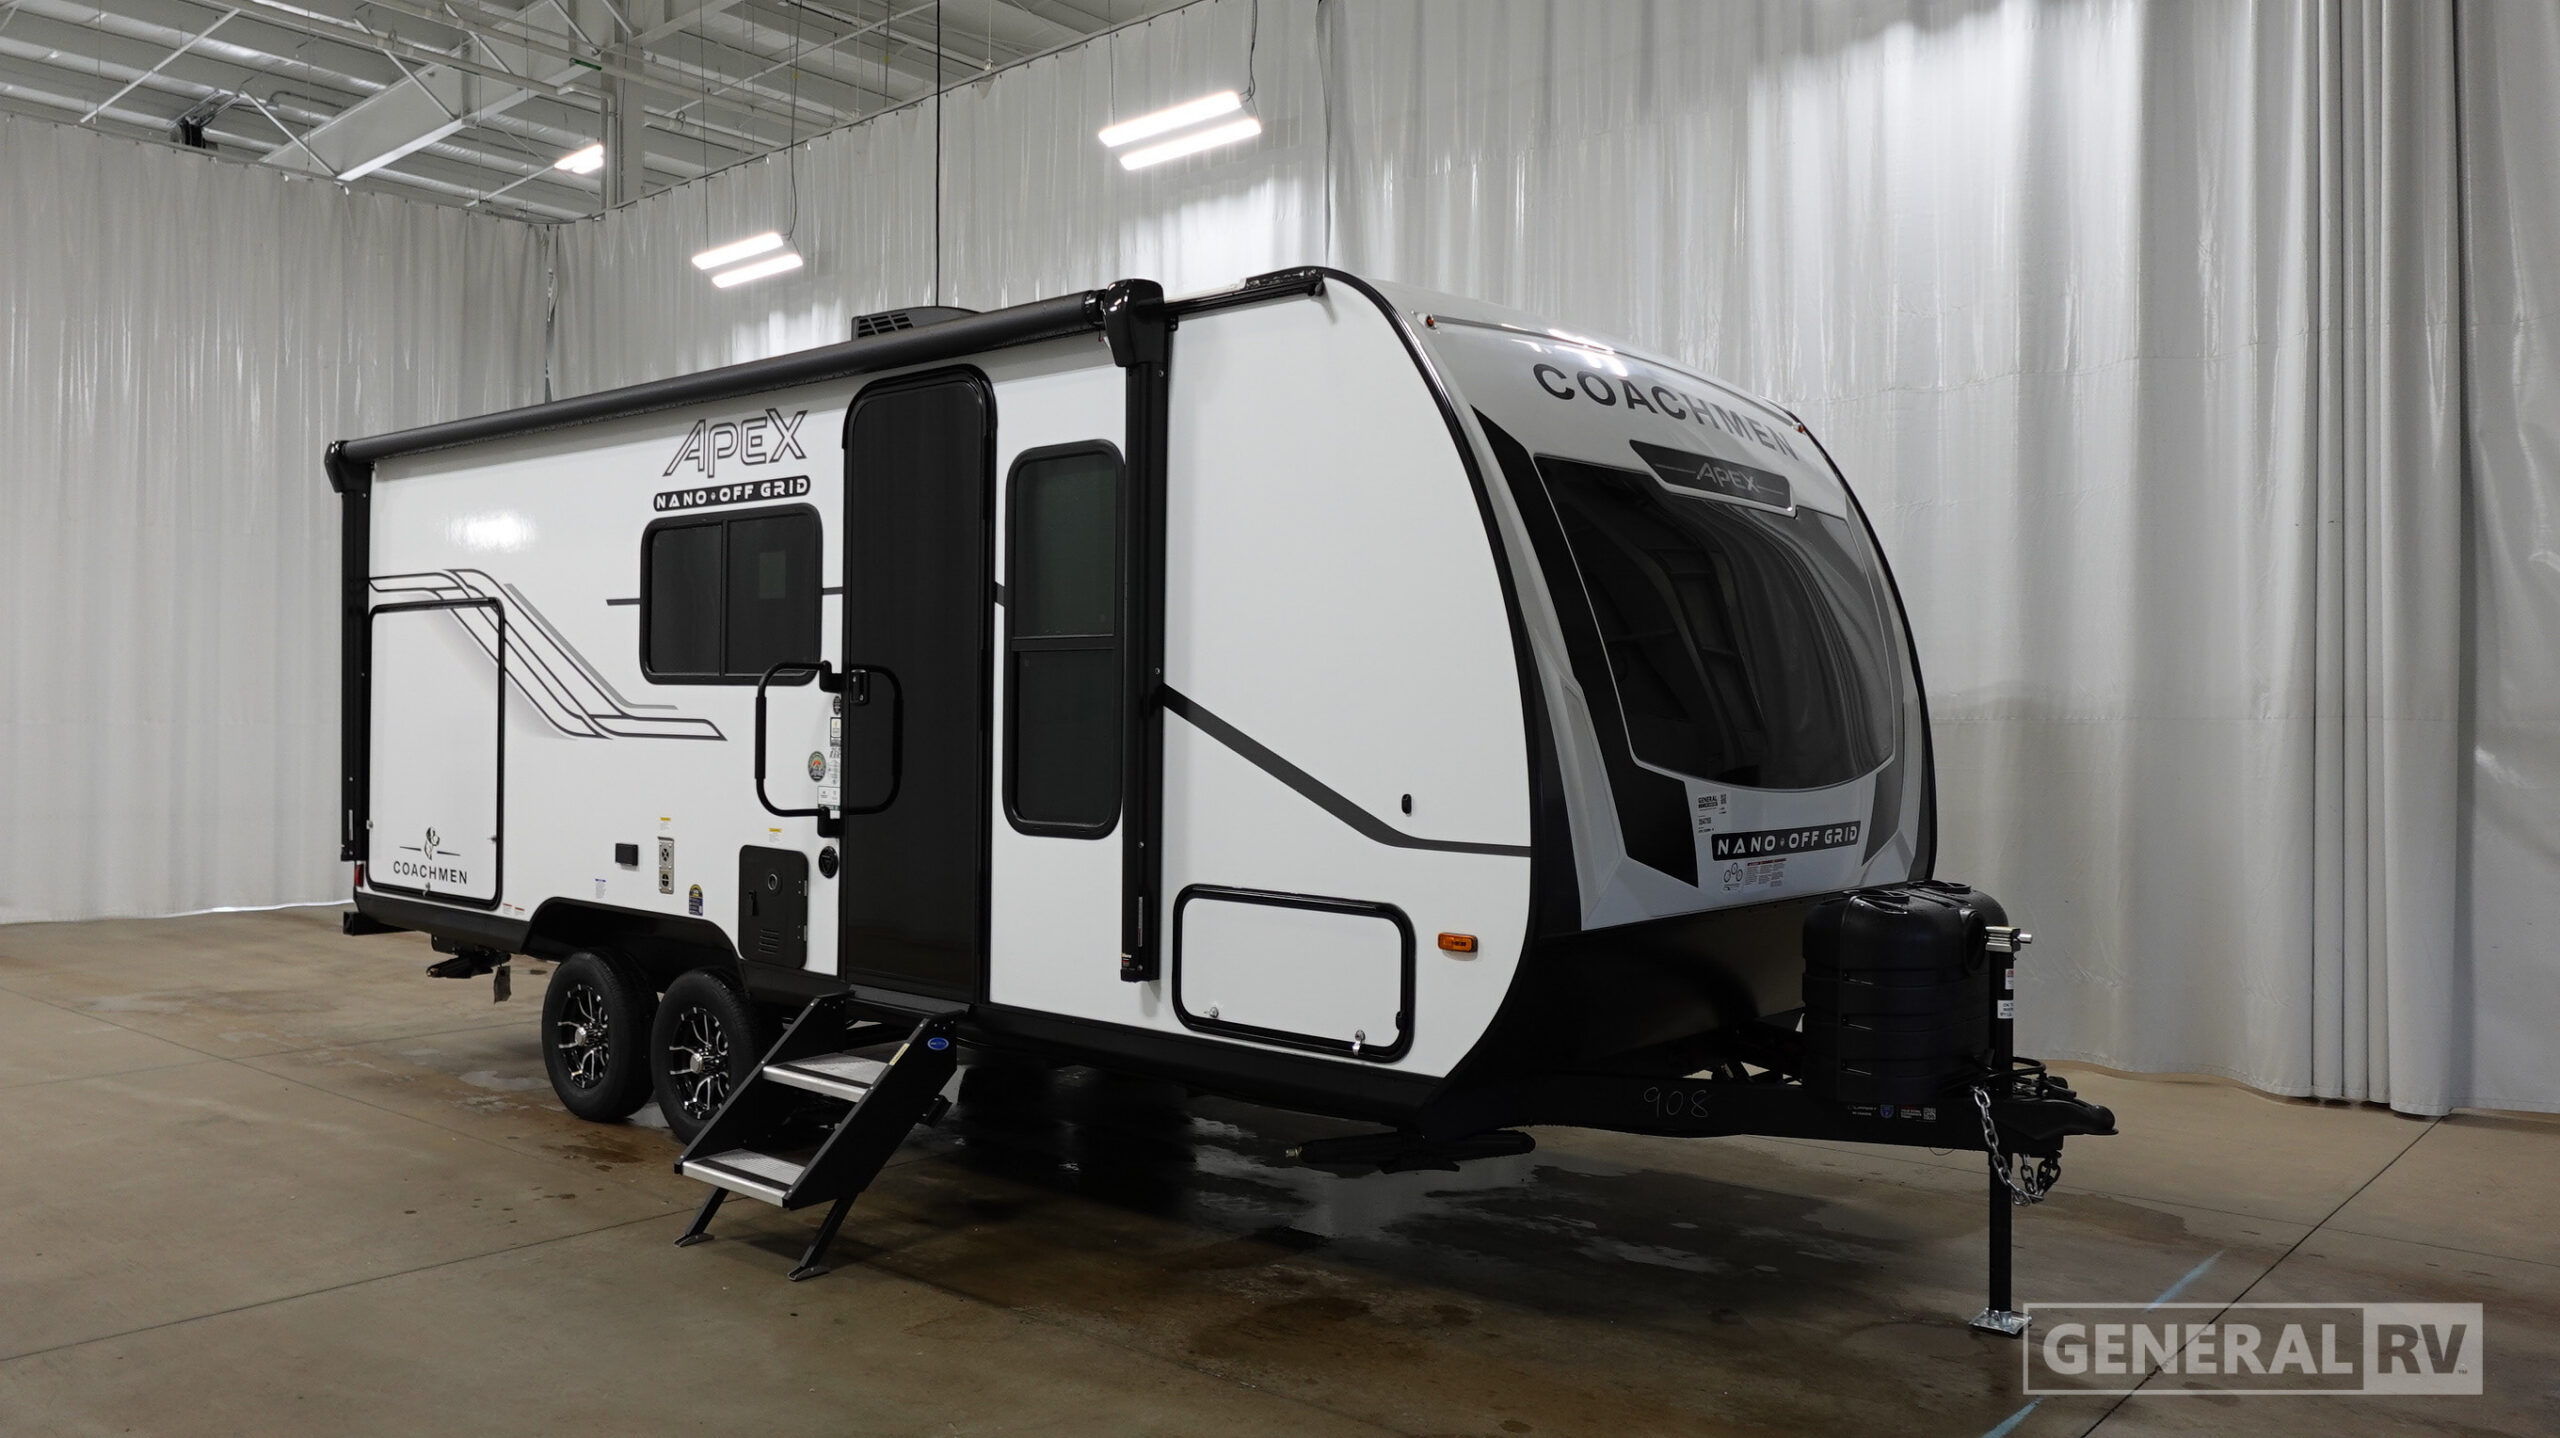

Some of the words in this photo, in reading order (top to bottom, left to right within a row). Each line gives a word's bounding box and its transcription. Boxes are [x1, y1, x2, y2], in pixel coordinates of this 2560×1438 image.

[1533, 363, 1799, 460] COACHMEN
[662, 408, 808, 478] APEX
[1696, 462, 1760, 492] APEX
[656, 493, 707, 509] NANO
[719, 485, 754, 502] OFF
[760, 478, 807, 498] GRID
[1717, 835, 1776, 856] NANO
[1788, 831, 1819, 849] OFF
[1824, 825, 1858, 844] GRID
[393, 860, 467, 884] COACHMEN
[1643, 1086, 1709, 1119] 908
